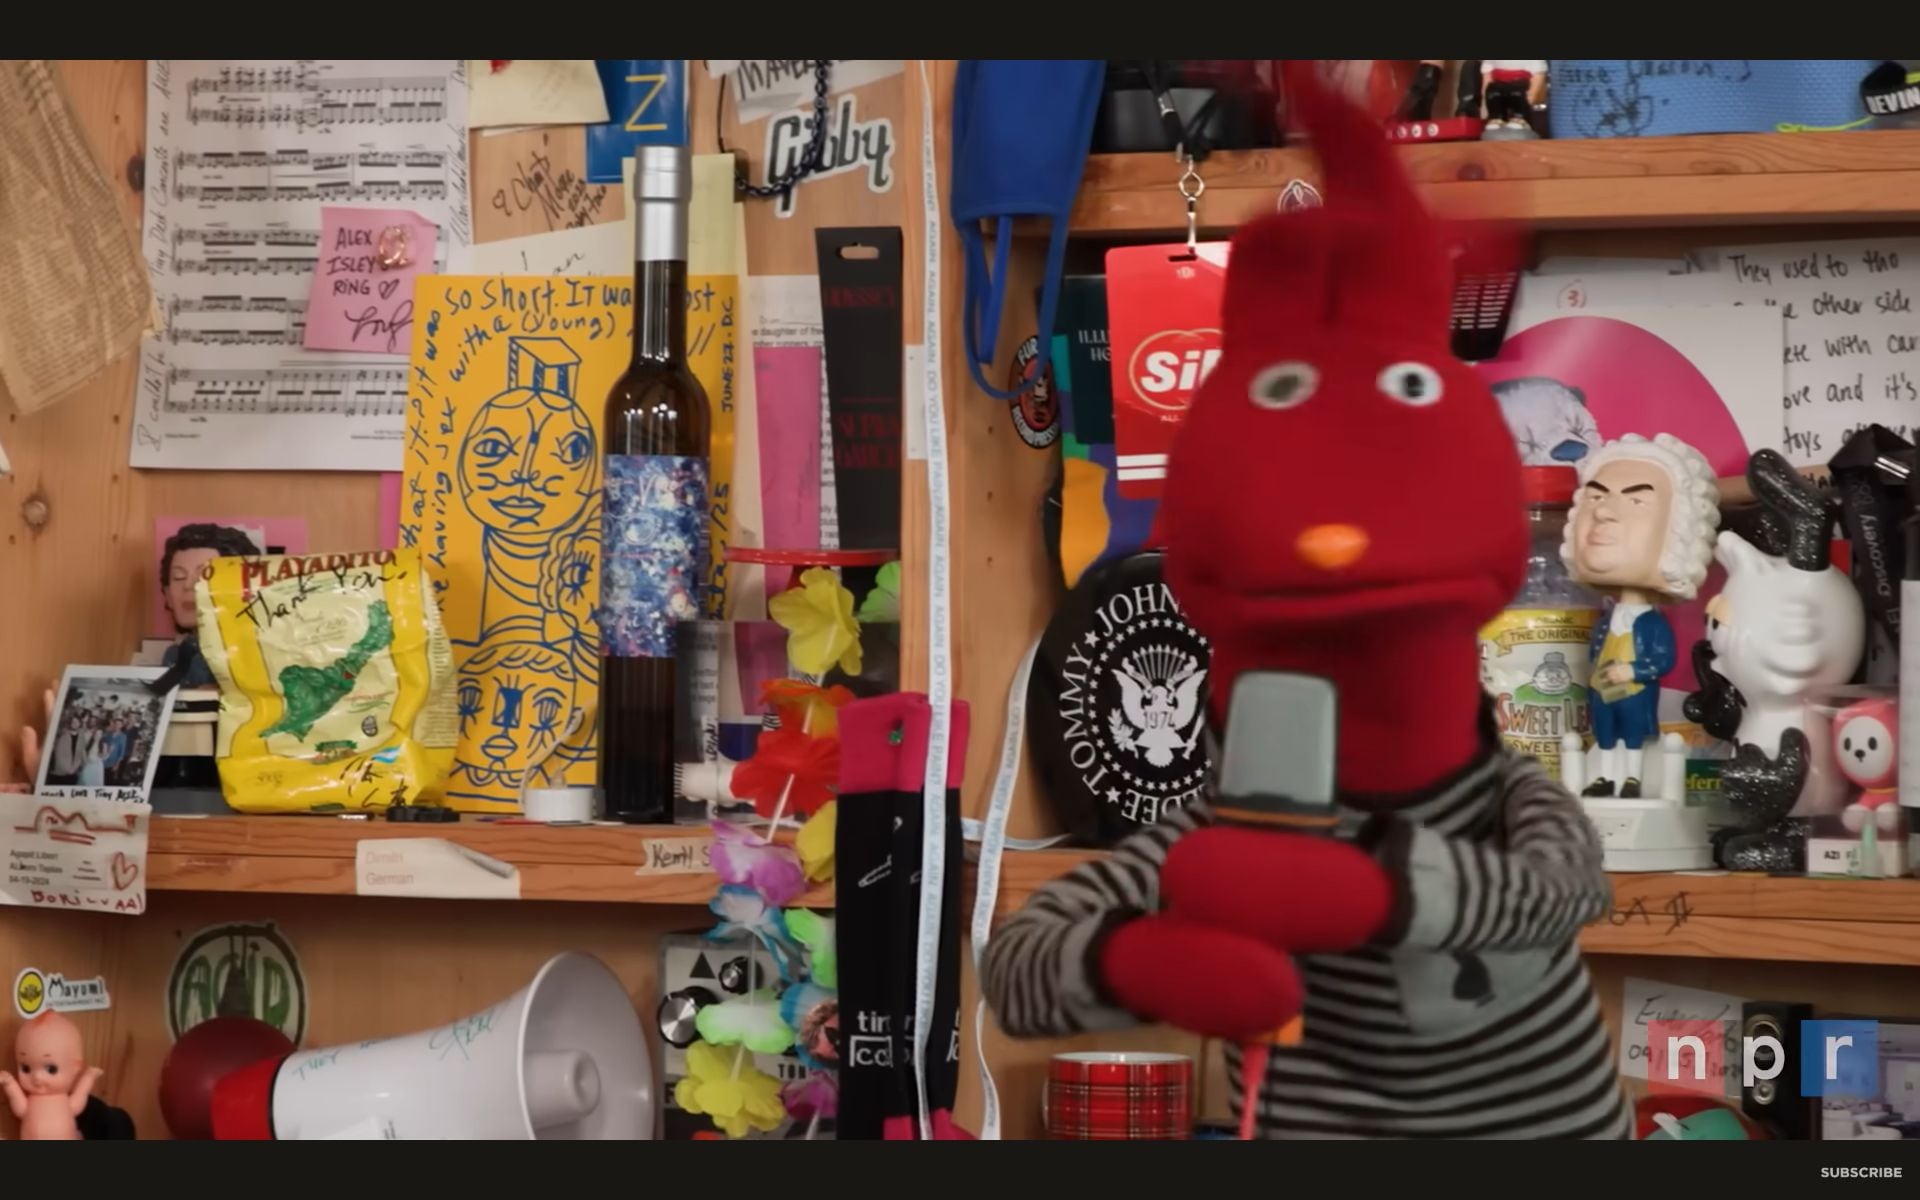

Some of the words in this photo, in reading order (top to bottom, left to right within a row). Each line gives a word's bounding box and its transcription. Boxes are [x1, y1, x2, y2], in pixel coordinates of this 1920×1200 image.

[335, 227, 373, 251] ALEX
[1727, 254, 1772, 285] They
[1783, 252, 1821, 279] used
[1825, 253, 1848, 277] to
[1812, 291, 1863, 316] other
[1874, 288, 1912, 313] side
[1824, 334, 1872, 357] with
[1826, 373, 1864, 402] and
[429, 472, 454, 569] having
[1095, 583, 1188, 637] JOHN
[1510, 631, 1534, 642] THE
[1059, 642, 1111, 796] TOMMY
